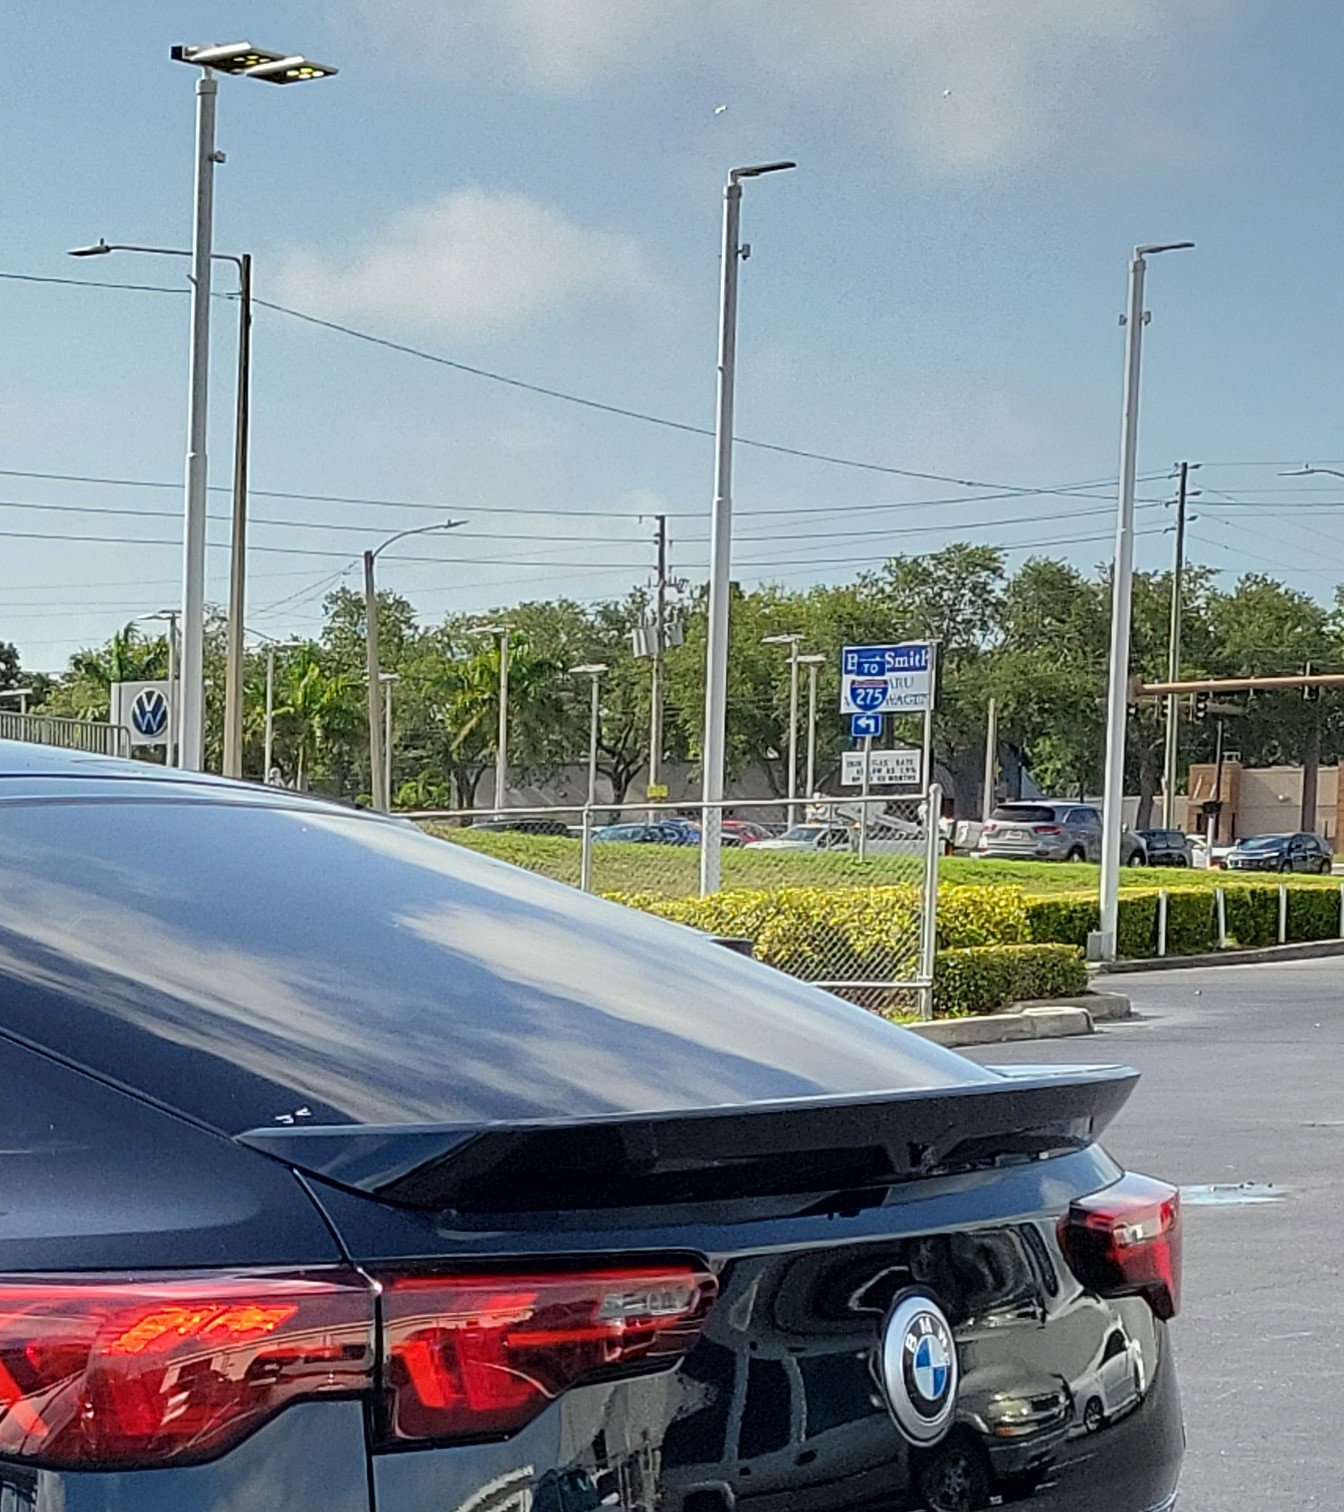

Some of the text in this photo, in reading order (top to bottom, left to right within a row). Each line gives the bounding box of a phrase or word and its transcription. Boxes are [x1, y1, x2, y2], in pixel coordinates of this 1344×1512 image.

[863, 664, 879, 673] TO
[856, 688, 883, 705] 275
[905, 1317, 948, 1354] BMW
